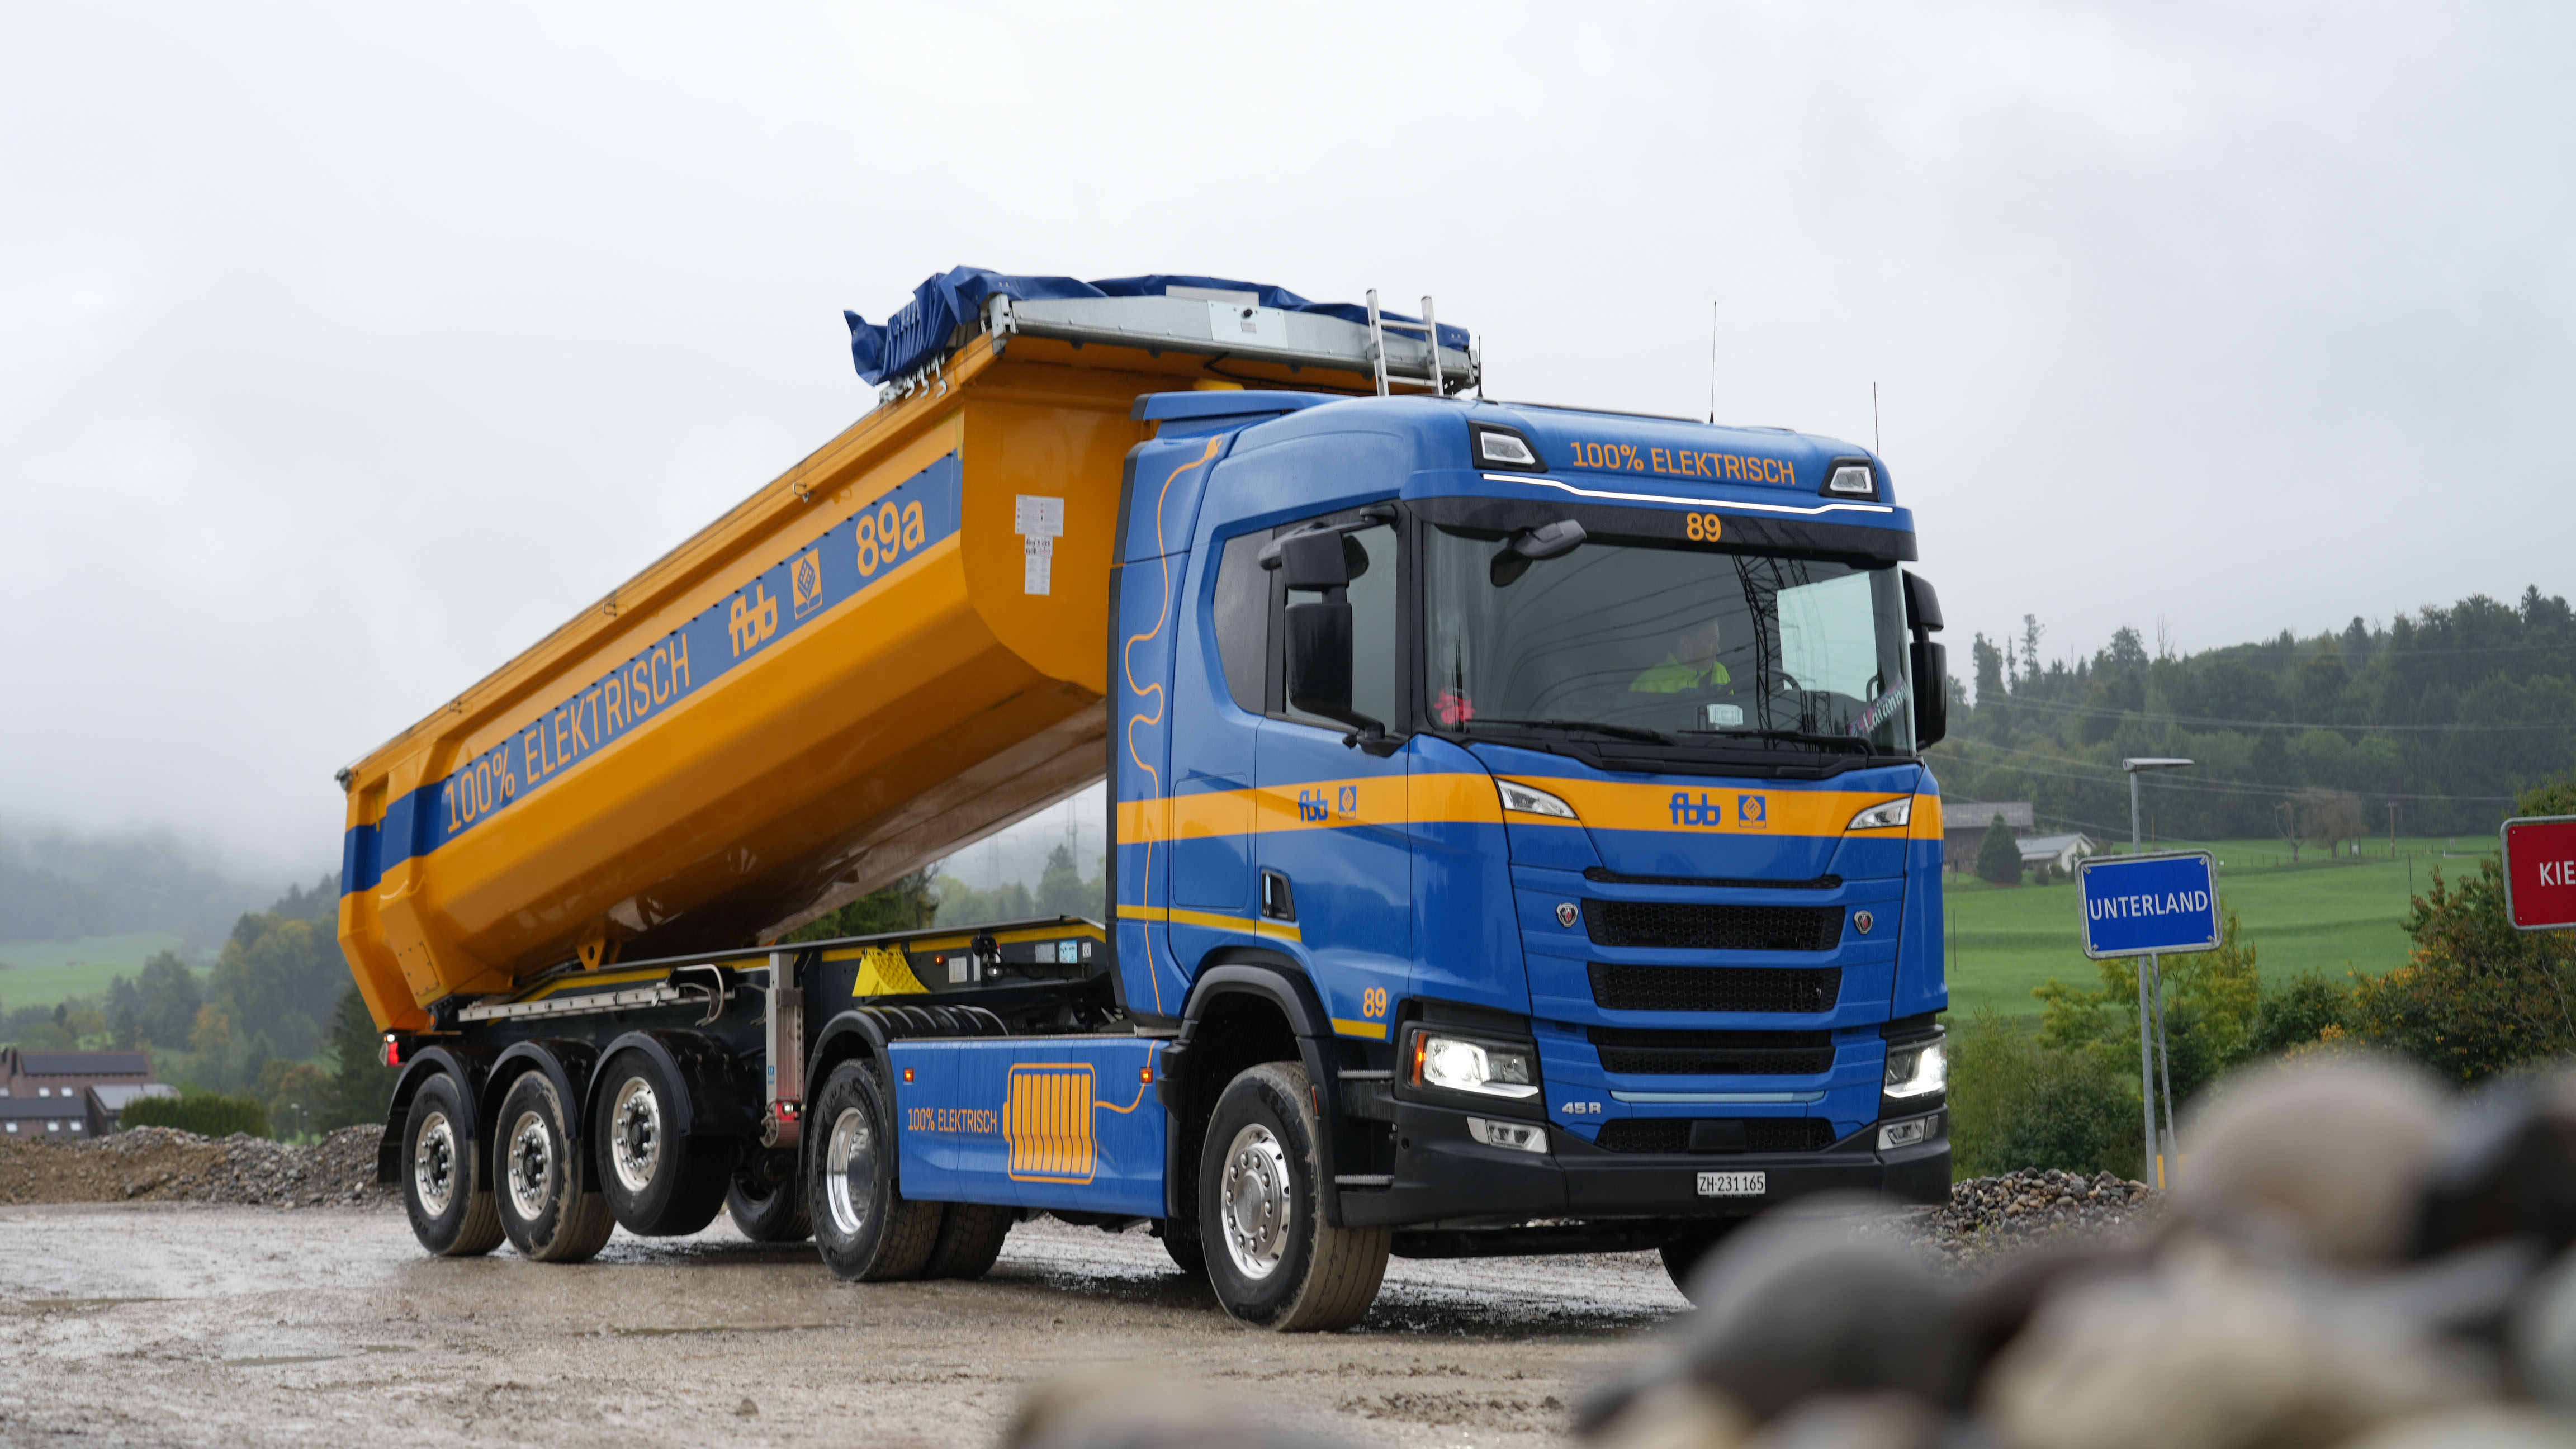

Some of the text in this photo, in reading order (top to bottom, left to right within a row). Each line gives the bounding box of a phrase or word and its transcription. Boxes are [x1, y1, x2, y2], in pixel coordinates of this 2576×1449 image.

[1571, 442, 1796, 485] 100% ELEKTRISCH
[856, 500, 926, 577] 89a
[1686, 512, 1722, 543] 89
[728, 584, 779, 659] fbb
[445, 633, 691, 833] 100% ELEKTRISCH
[1298, 789, 1328, 822] fbb
[1669, 792, 1721, 826] fbb
[2539, 860, 2576, 887] KIE
[2089, 890, 2208, 920] UNTERLAND
[1363, 987, 1387, 1017] 89
[907, 1107, 998, 1134] 100% ELEKTRISCH
